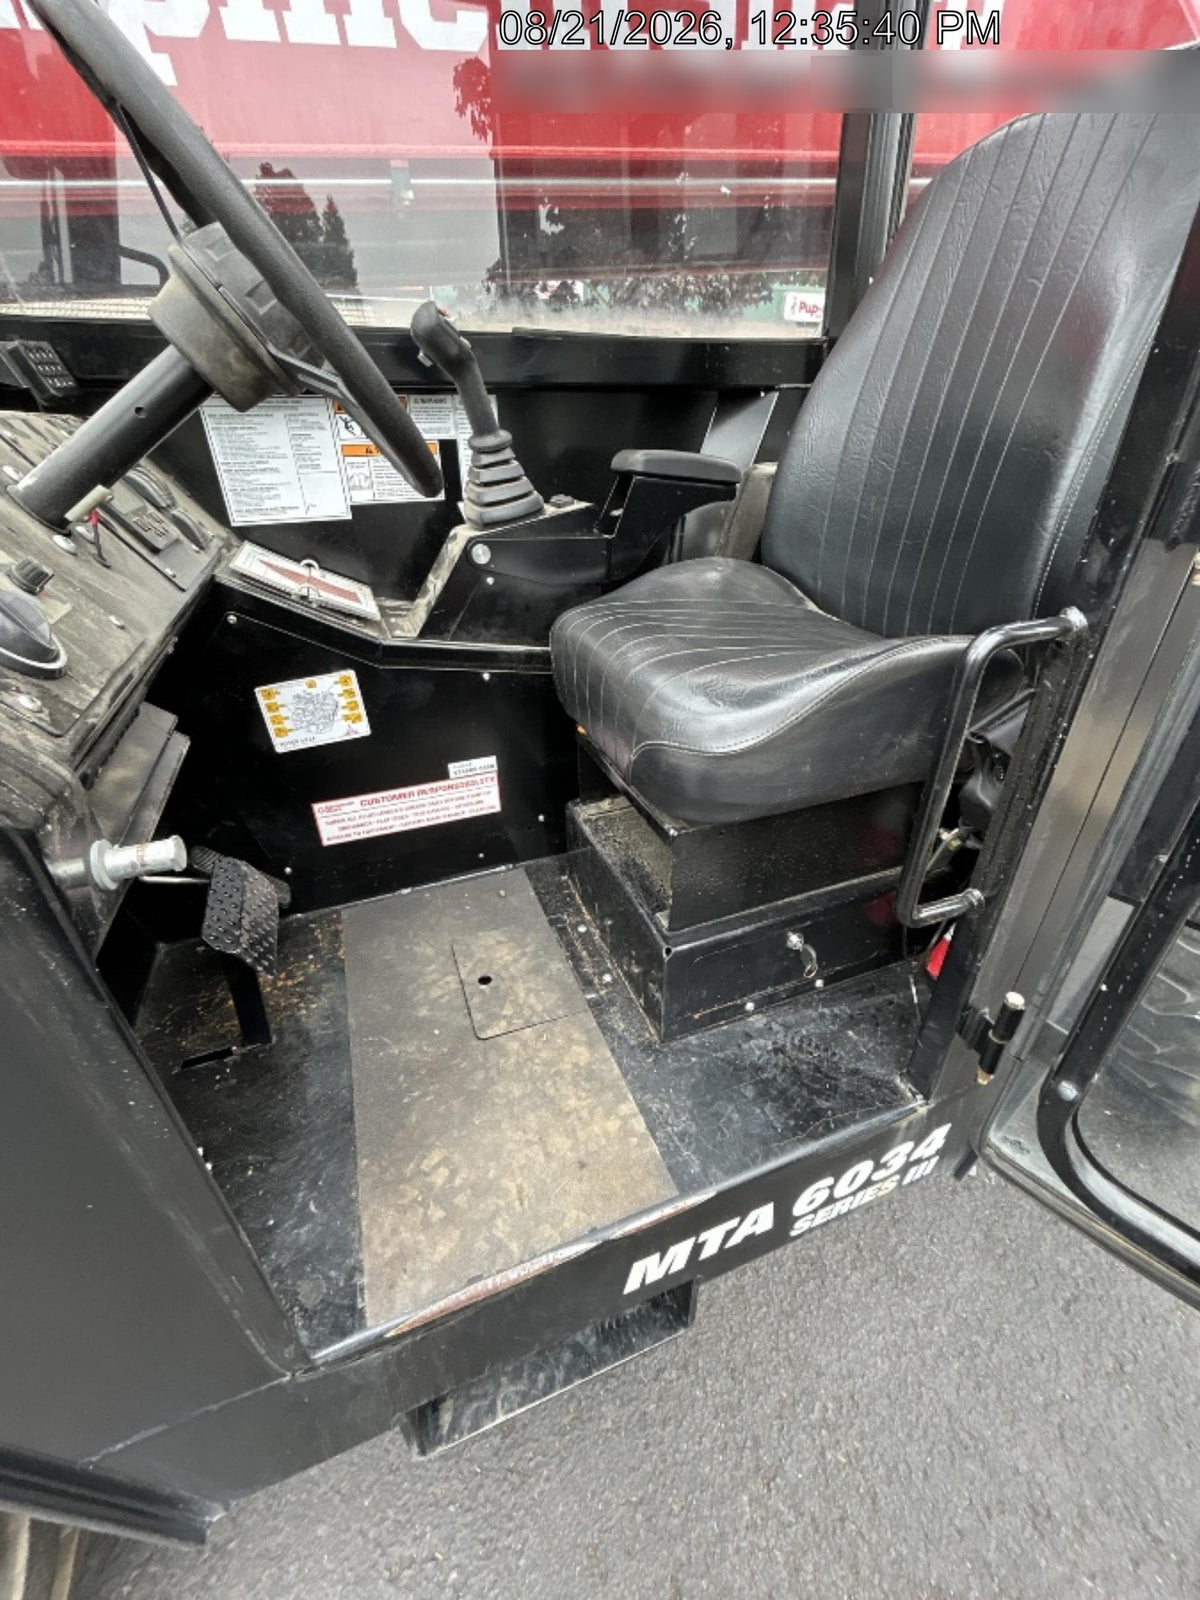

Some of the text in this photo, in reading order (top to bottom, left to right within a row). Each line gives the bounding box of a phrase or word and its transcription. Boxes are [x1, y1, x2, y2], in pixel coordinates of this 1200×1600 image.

[359, 776, 497, 807] CUSTOMER RESPONSIBILITY
[623, 1122, 952, 1296] MTA 6034
[789, 1155, 940, 1238] SERIES III
